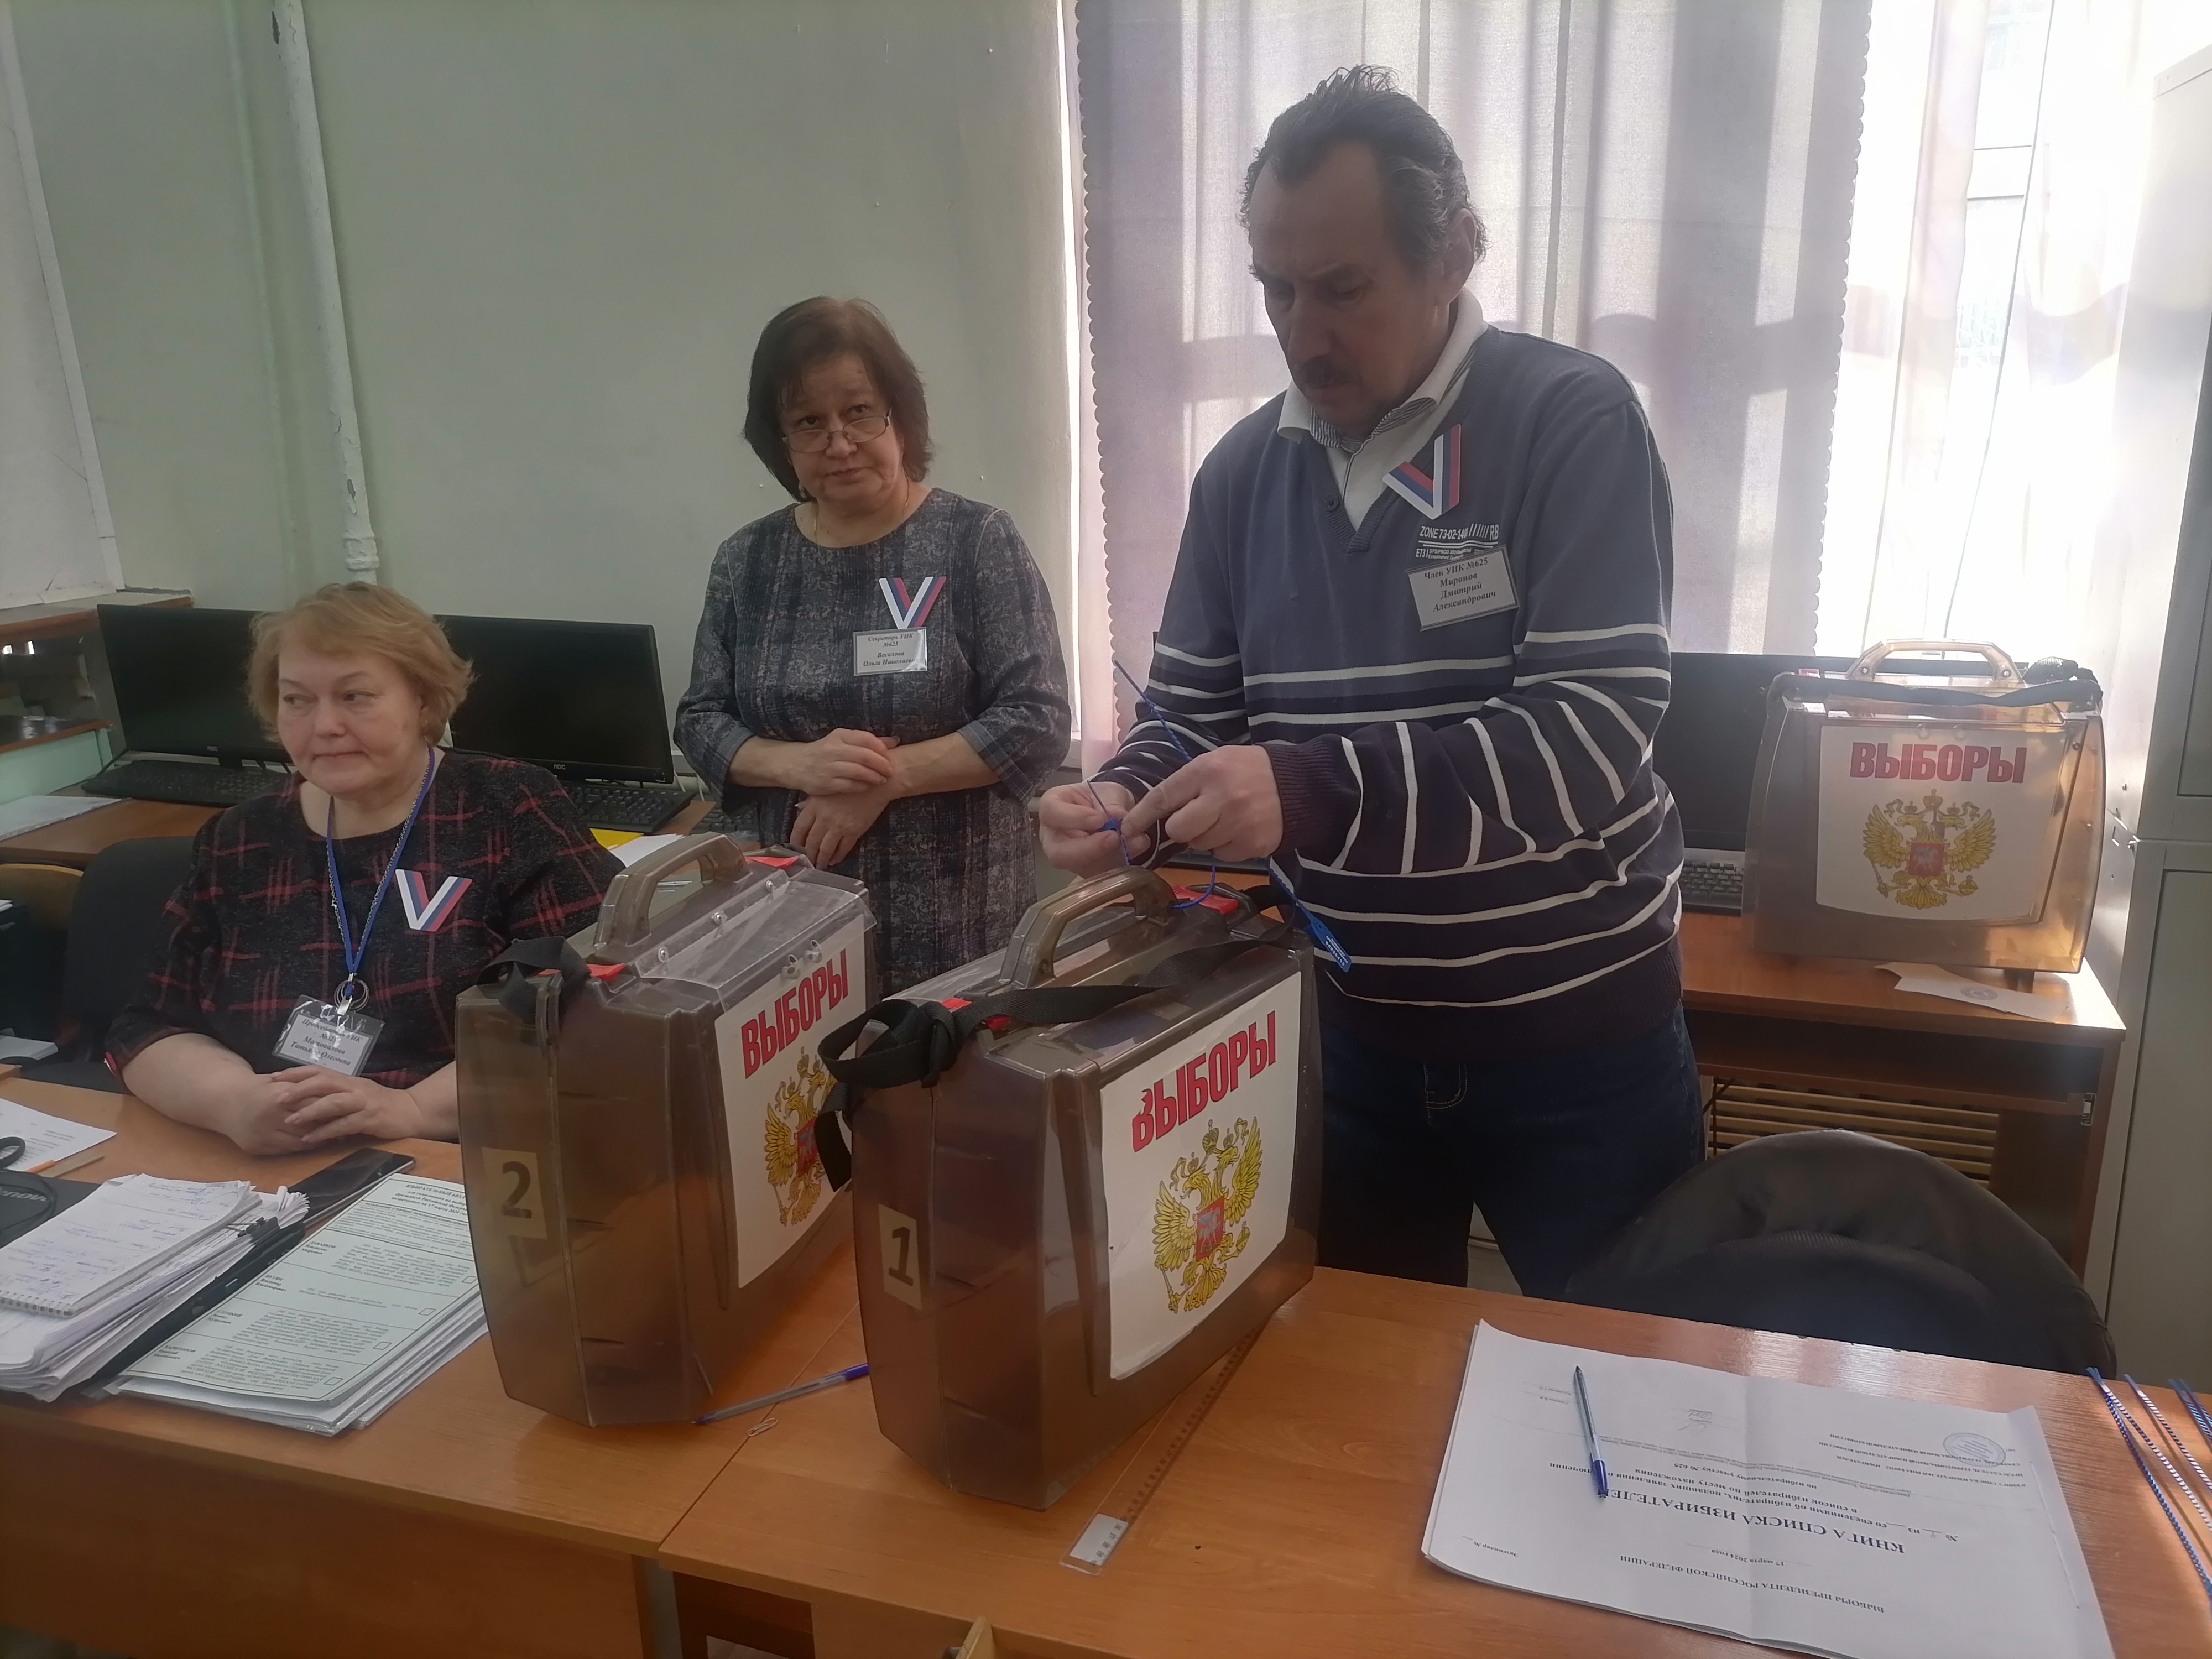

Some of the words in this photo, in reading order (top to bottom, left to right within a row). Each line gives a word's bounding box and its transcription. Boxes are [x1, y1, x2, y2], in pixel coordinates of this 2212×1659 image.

[1420, 526, 1439, 539] ZONE
[1425, 571, 1443, 580] Член
[1446, 563, 1465, 575] УИК
[1466, 557, 1488, 570] №625
[1440, 573, 1478, 587] Миронов
[1441, 582, 1483, 600] Дмитрий
[1433, 591, 1496, 612] Александрович
[1850, 742, 2027, 784] ВЫБОРЫ
[741, 948, 848, 1079] ВЫБОРЫ
[321, 1051, 352, 1066] Олеговна
[1132, 1010, 1276, 1152] ВЫБОРЫ
[502, 1161, 532, 1219] 2
[889, 1227, 914, 1287] 1
[1550, 1462, 1592, 1473] лючении
[1702, 1466, 1734, 1477] участку
[1616, 1473, 1668, 1486] заявления
[1635, 1468, 1694, 1485] нахождения
[1697, 1479, 1726, 1490] месту
[1735, 1473, 1804, 1487] избирательному
[1670, 1483, 1721, 1496] подавших
[1744, 1490, 1808, 1502] избирателей
[1723, 1492, 1791, 1507] избирателях,
[1811, 1498, 1848, 1511] список
[1809, 1506, 1872, 1525] сведениями
[1741, 1514, 1827, 1535] СПИСКА
[1832, 1528, 1904, 1553] КНИГА
[1945, 1533, 1958, 1542] №
[1620, 1554, 1683, 1572] ФЕДЕРАЦИИ
[1730, 1552, 1747, 1563] 2024
[1686, 1567, 1758, 1589] РОССИЙСКОЙ
[1761, 1582, 1832, 1600] ПРЕЗИДЕНТА
[1835, 1595, 1884, 1613] ВЫБОРЫ
